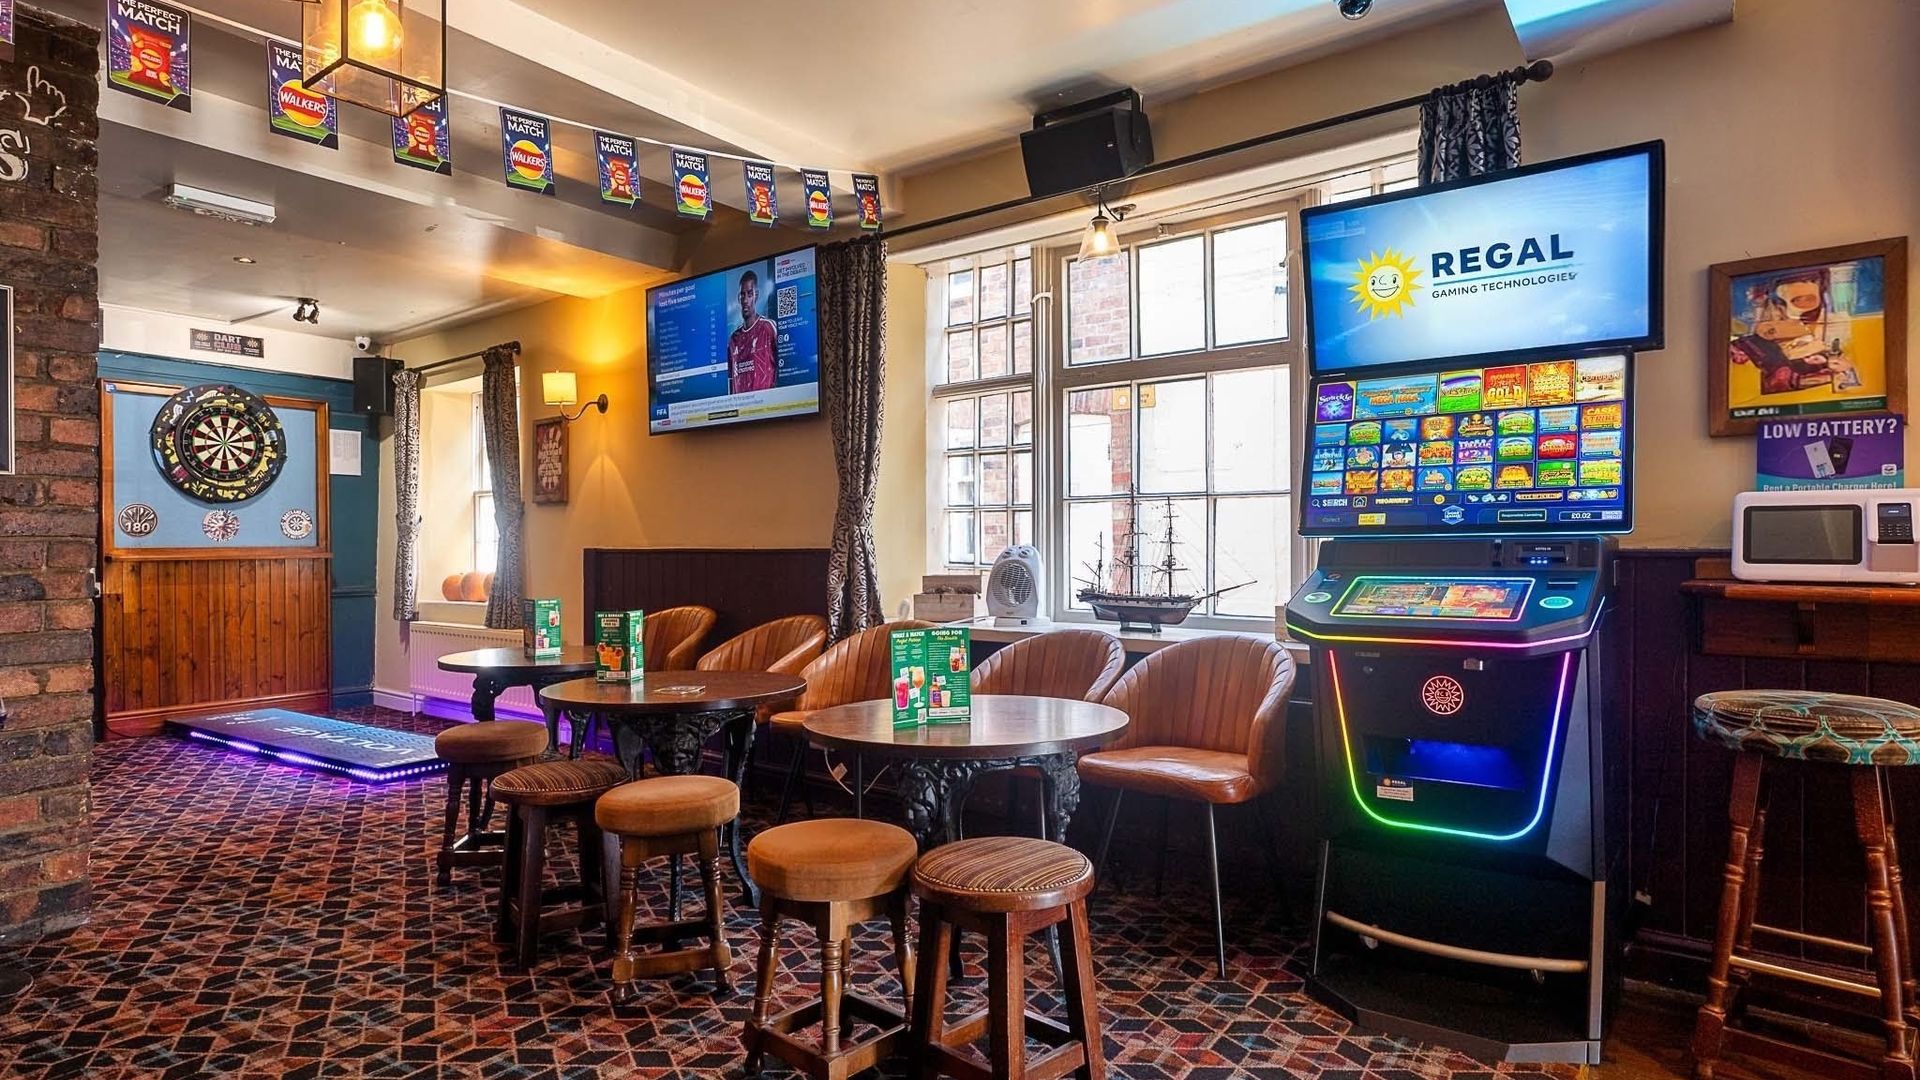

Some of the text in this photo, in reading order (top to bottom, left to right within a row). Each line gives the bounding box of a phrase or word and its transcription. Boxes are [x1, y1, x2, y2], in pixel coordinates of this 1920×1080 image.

[117, 3, 180, 35] MATCH
[137, 2, 182, 23] PERFECT
[274, 47, 292, 58] THE
[280, 91, 326, 115] WALKERS
[506, 114, 544, 129] THE PERFECT
[508, 121, 544, 138] MATCH
[600, 136, 632, 149] THE PERFECT
[601, 142, 632, 156] MATCH
[512, 151, 545, 167] WALKERS
[676, 159, 705, 172] MATCH
[685, 154, 704, 164] PERFECT
[748, 170, 771, 181] MATCH
[806, 179, 827, 187] MATCH
[857, 183, 875, 191] MATCH
[681, 184, 705, 197] WALKERS
[1432, 234, 1574, 278] REGAL
[1432, 285, 1478, 298] GAMING
[214, 333, 241, 343] DART
[1487, 385, 1522, 402] GOLD
[1587, 406, 1616, 415] CASH
[1763, 418, 1897, 439] LOW BATTERY?
[1764, 484, 1783, 492] Rent
[1832, 482, 1869, 490] Charger
[1323, 498, 1347, 507] SEARCH
[125, 522, 151, 532] 180
